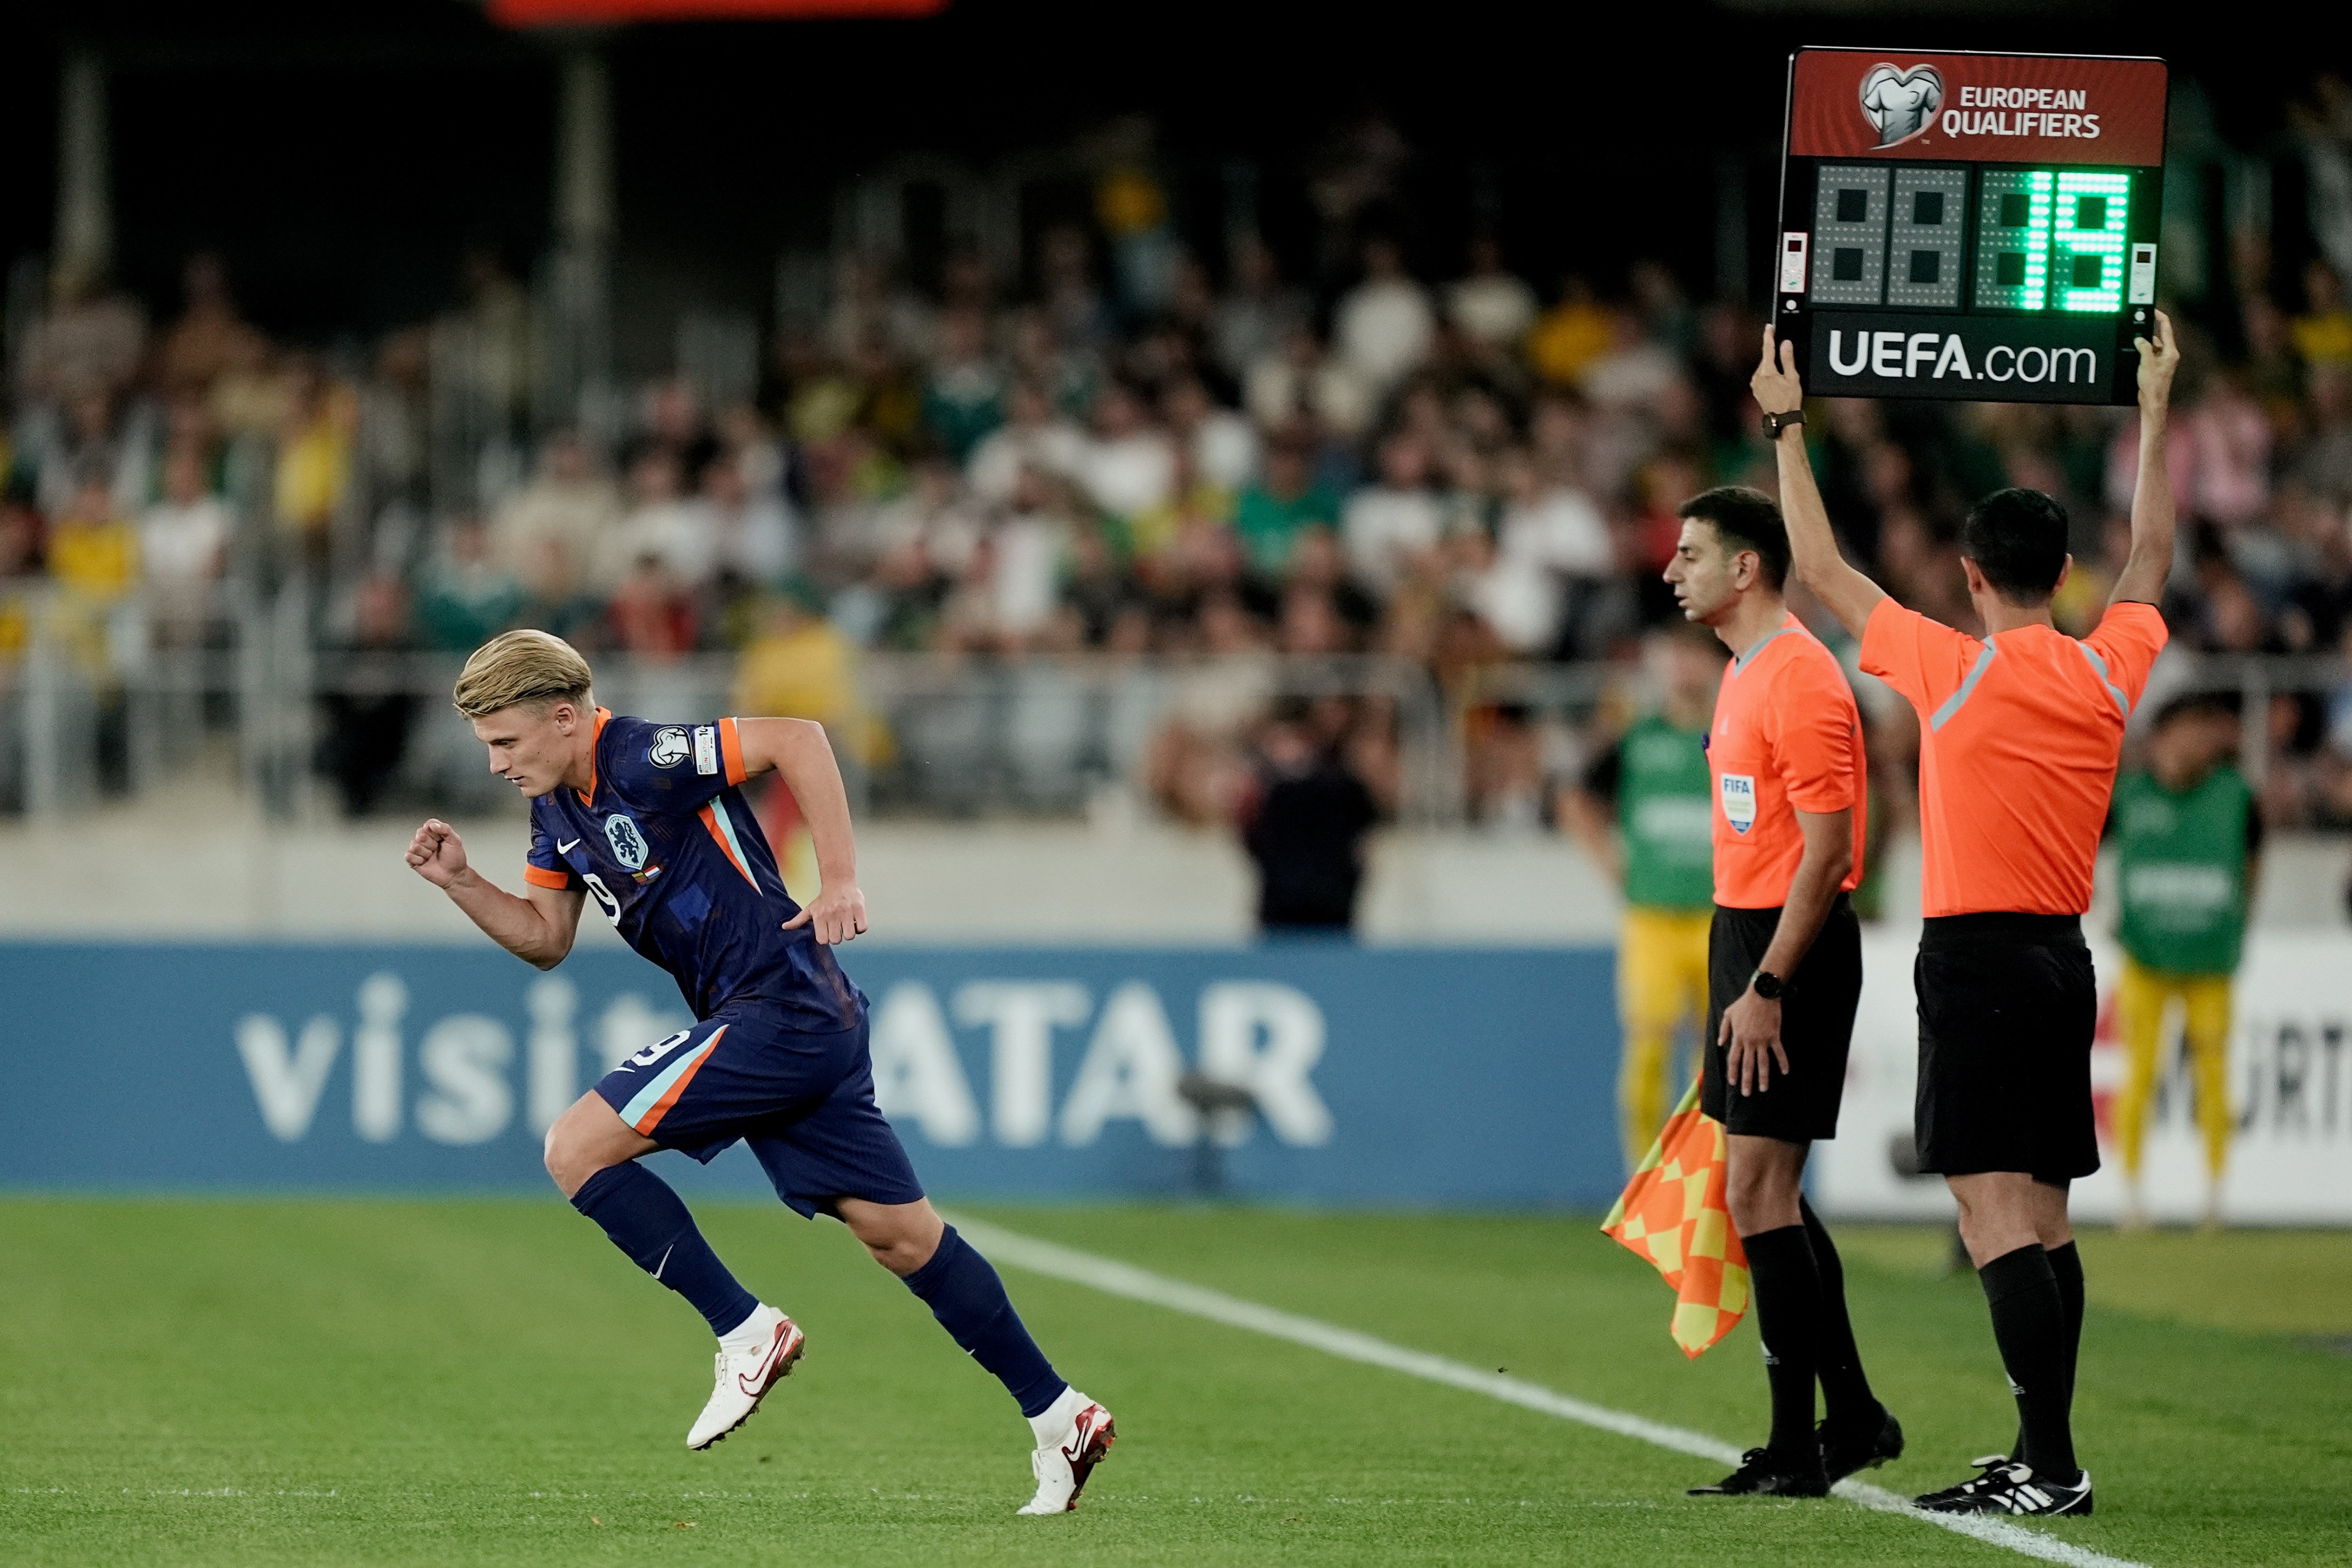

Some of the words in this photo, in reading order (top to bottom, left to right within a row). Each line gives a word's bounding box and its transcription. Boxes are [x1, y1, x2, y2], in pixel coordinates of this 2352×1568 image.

[1960, 86, 2087, 110] EUROPEAN
[1942, 110, 2100, 139] QUALIFIERS
[2025, 171, 2131, 313] 19
[1829, 330, 2097, 383] UEFA.com
[1724, 778, 1750, 794] FIFA
[872, 979, 1335, 1147] ATAR
